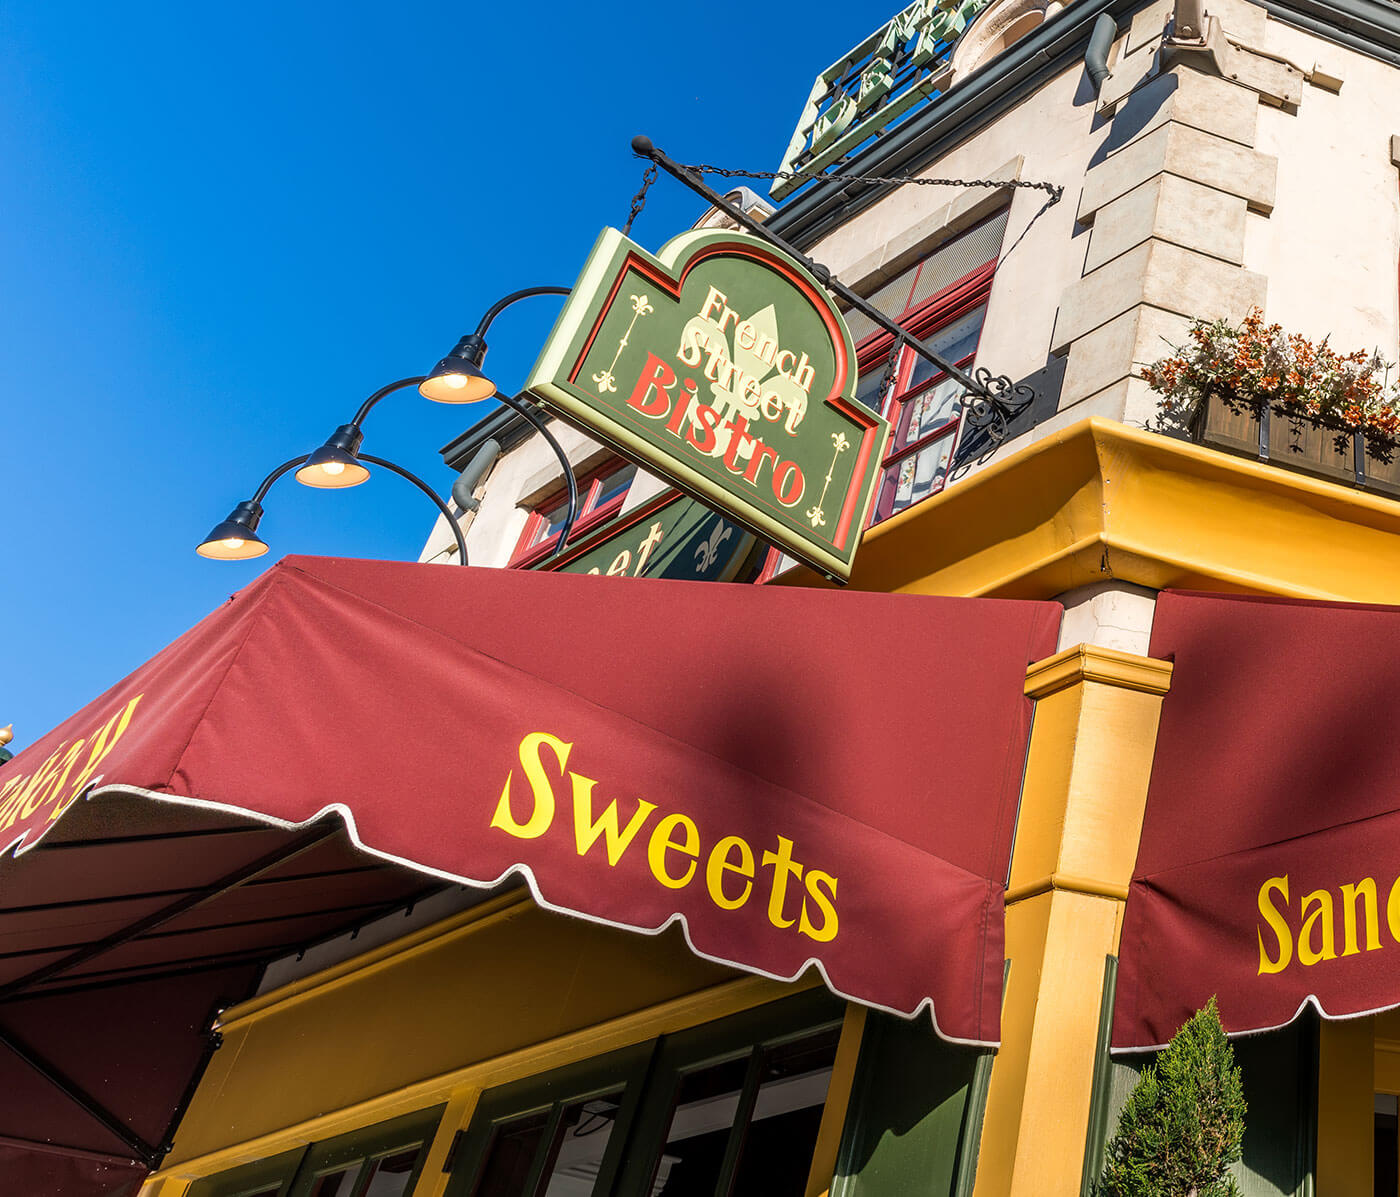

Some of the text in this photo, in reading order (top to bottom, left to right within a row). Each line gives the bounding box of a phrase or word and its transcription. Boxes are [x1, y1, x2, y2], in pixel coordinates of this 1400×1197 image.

[676, 326, 806, 437] Street
[698, 285, 816, 393] French
[625, 351, 806, 508] Bistro
[490, 732, 839, 942] Sweets
